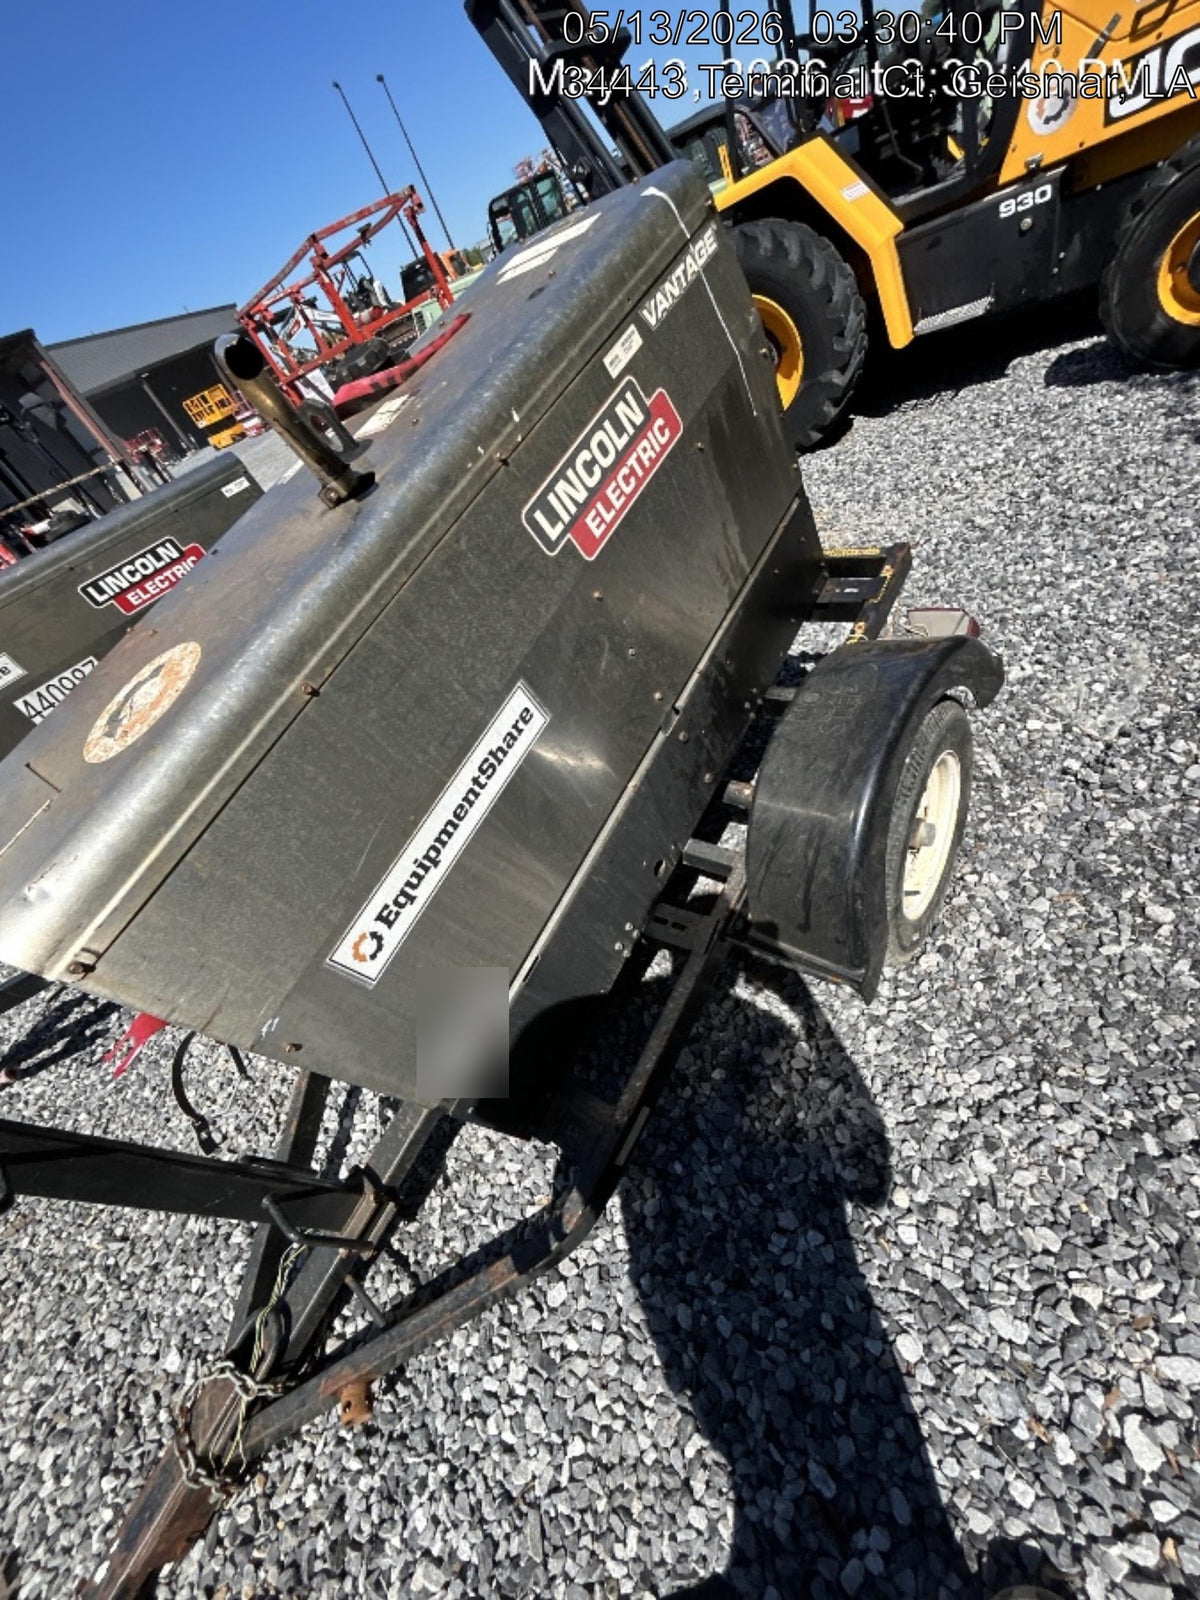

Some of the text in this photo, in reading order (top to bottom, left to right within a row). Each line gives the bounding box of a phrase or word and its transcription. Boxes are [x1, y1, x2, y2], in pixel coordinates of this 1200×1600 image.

[999, 184, 1052, 218] 930
[641, 226, 718, 327] VANTAGE
[533, 391, 645, 541] LINCOLN
[585, 417, 670, 538] ELECTRIC
[86, 542, 180, 603] LINCOLN
[22, 659, 96, 719] 4409
[374, 706, 534, 930] EquipmentShare
